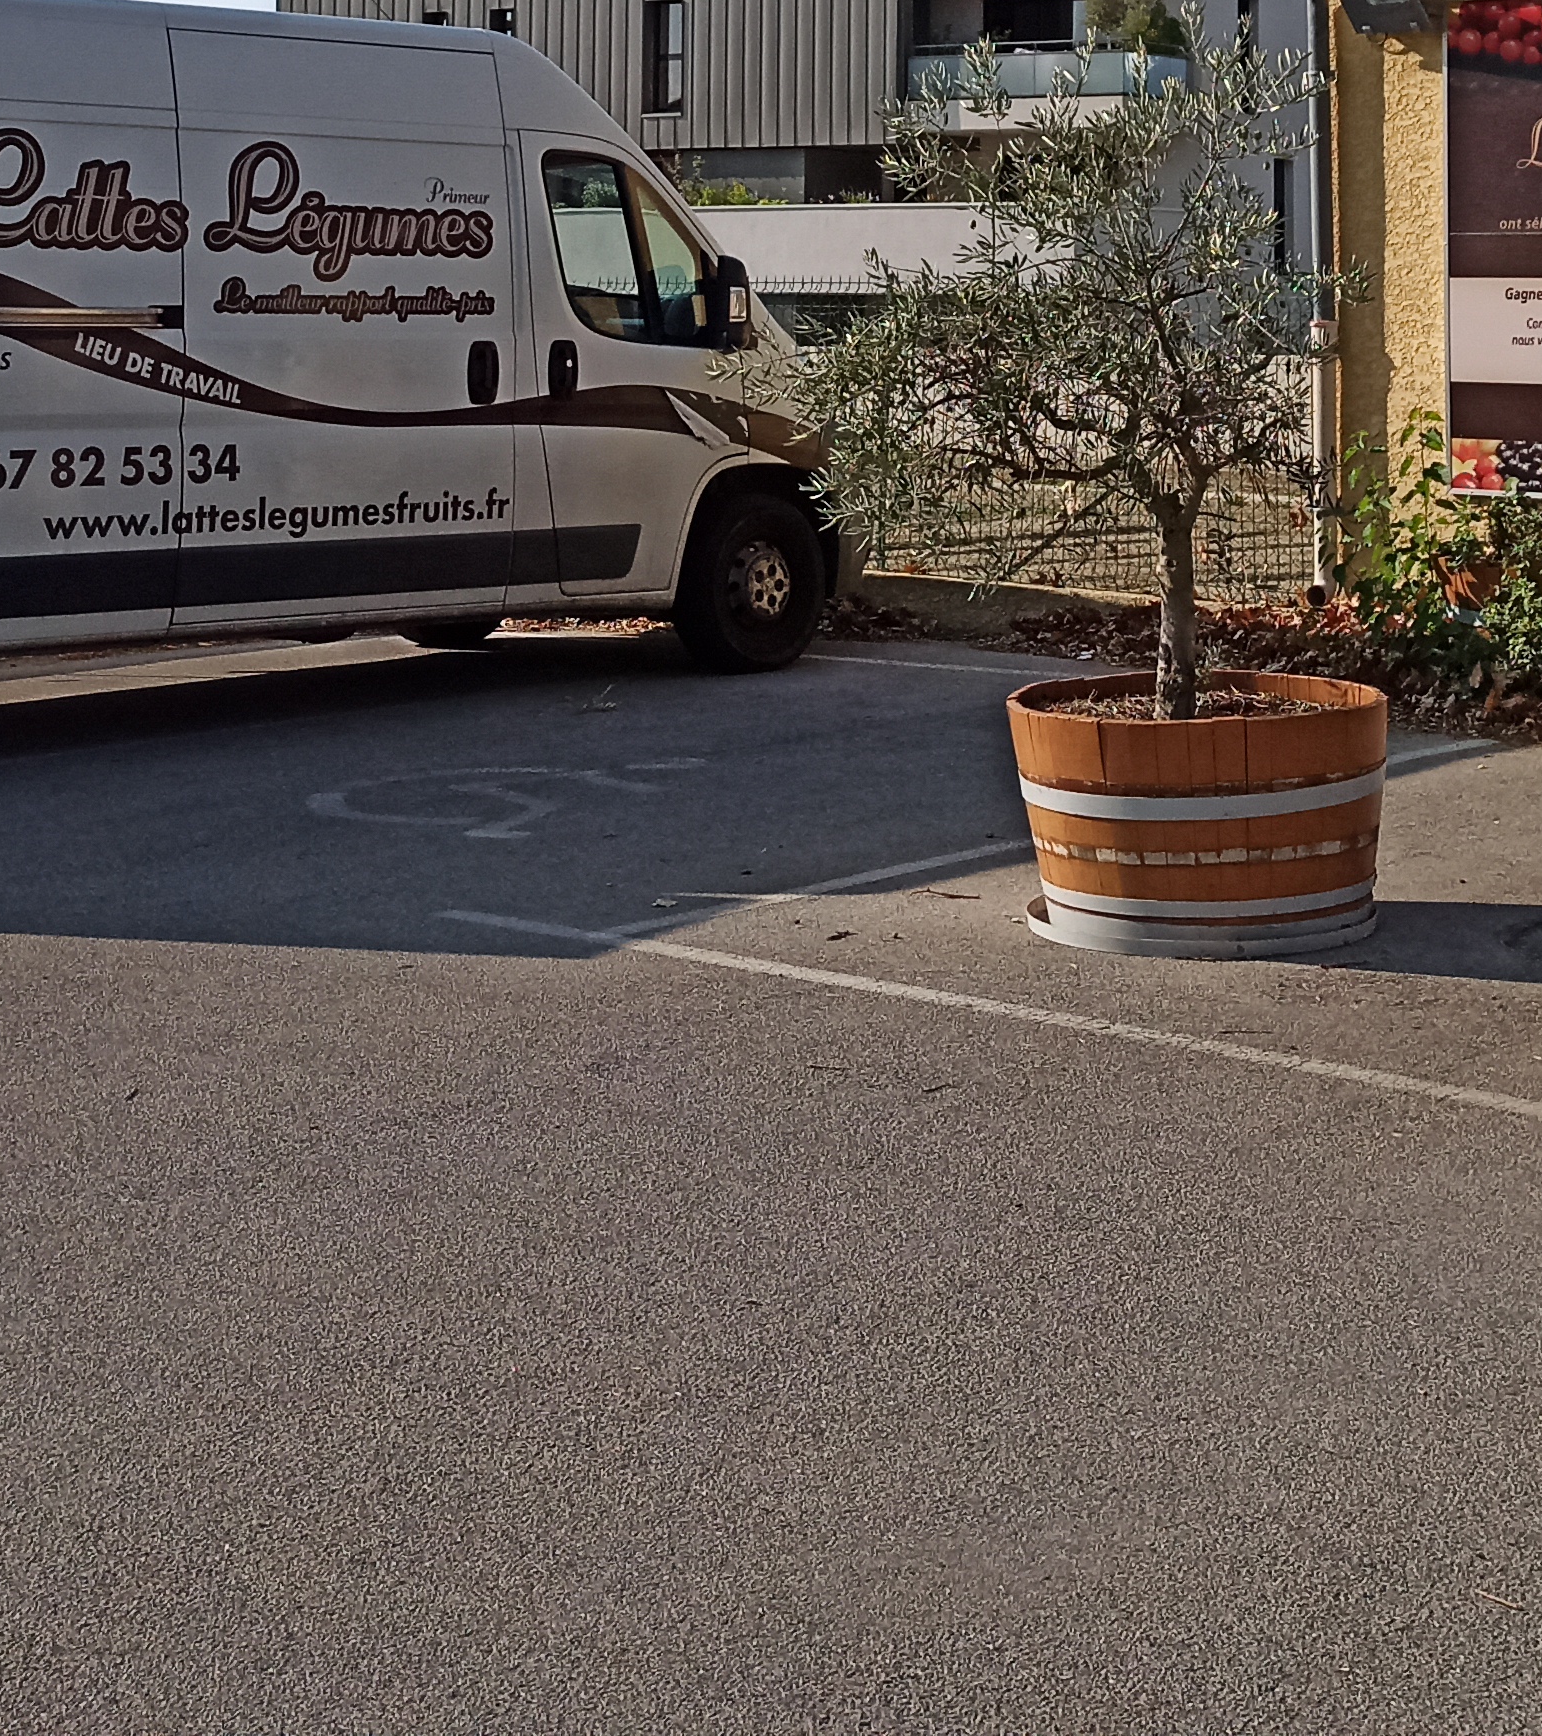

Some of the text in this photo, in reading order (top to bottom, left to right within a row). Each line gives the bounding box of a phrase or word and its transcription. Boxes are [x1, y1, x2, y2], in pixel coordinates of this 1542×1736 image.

[203, 140, 494, 282] Légumes
[423, 177, 490, 206] Primeur
[1499, 218, 1522, 230] ont
[215, 277, 253, 312] Le
[254, 285, 325, 312] meilleur
[327, 287, 394, 320] rapport
[1511, 336, 1535, 346] nous
[74, 332, 241, 404] LIEU DE TRAVAIL
[50, 447, 107, 489] 82
[120, 445, 173, 486] 53
[187, 443, 241, 483] 34
[43, 487, 510, 541] www.latteslegumesfruits.fr
